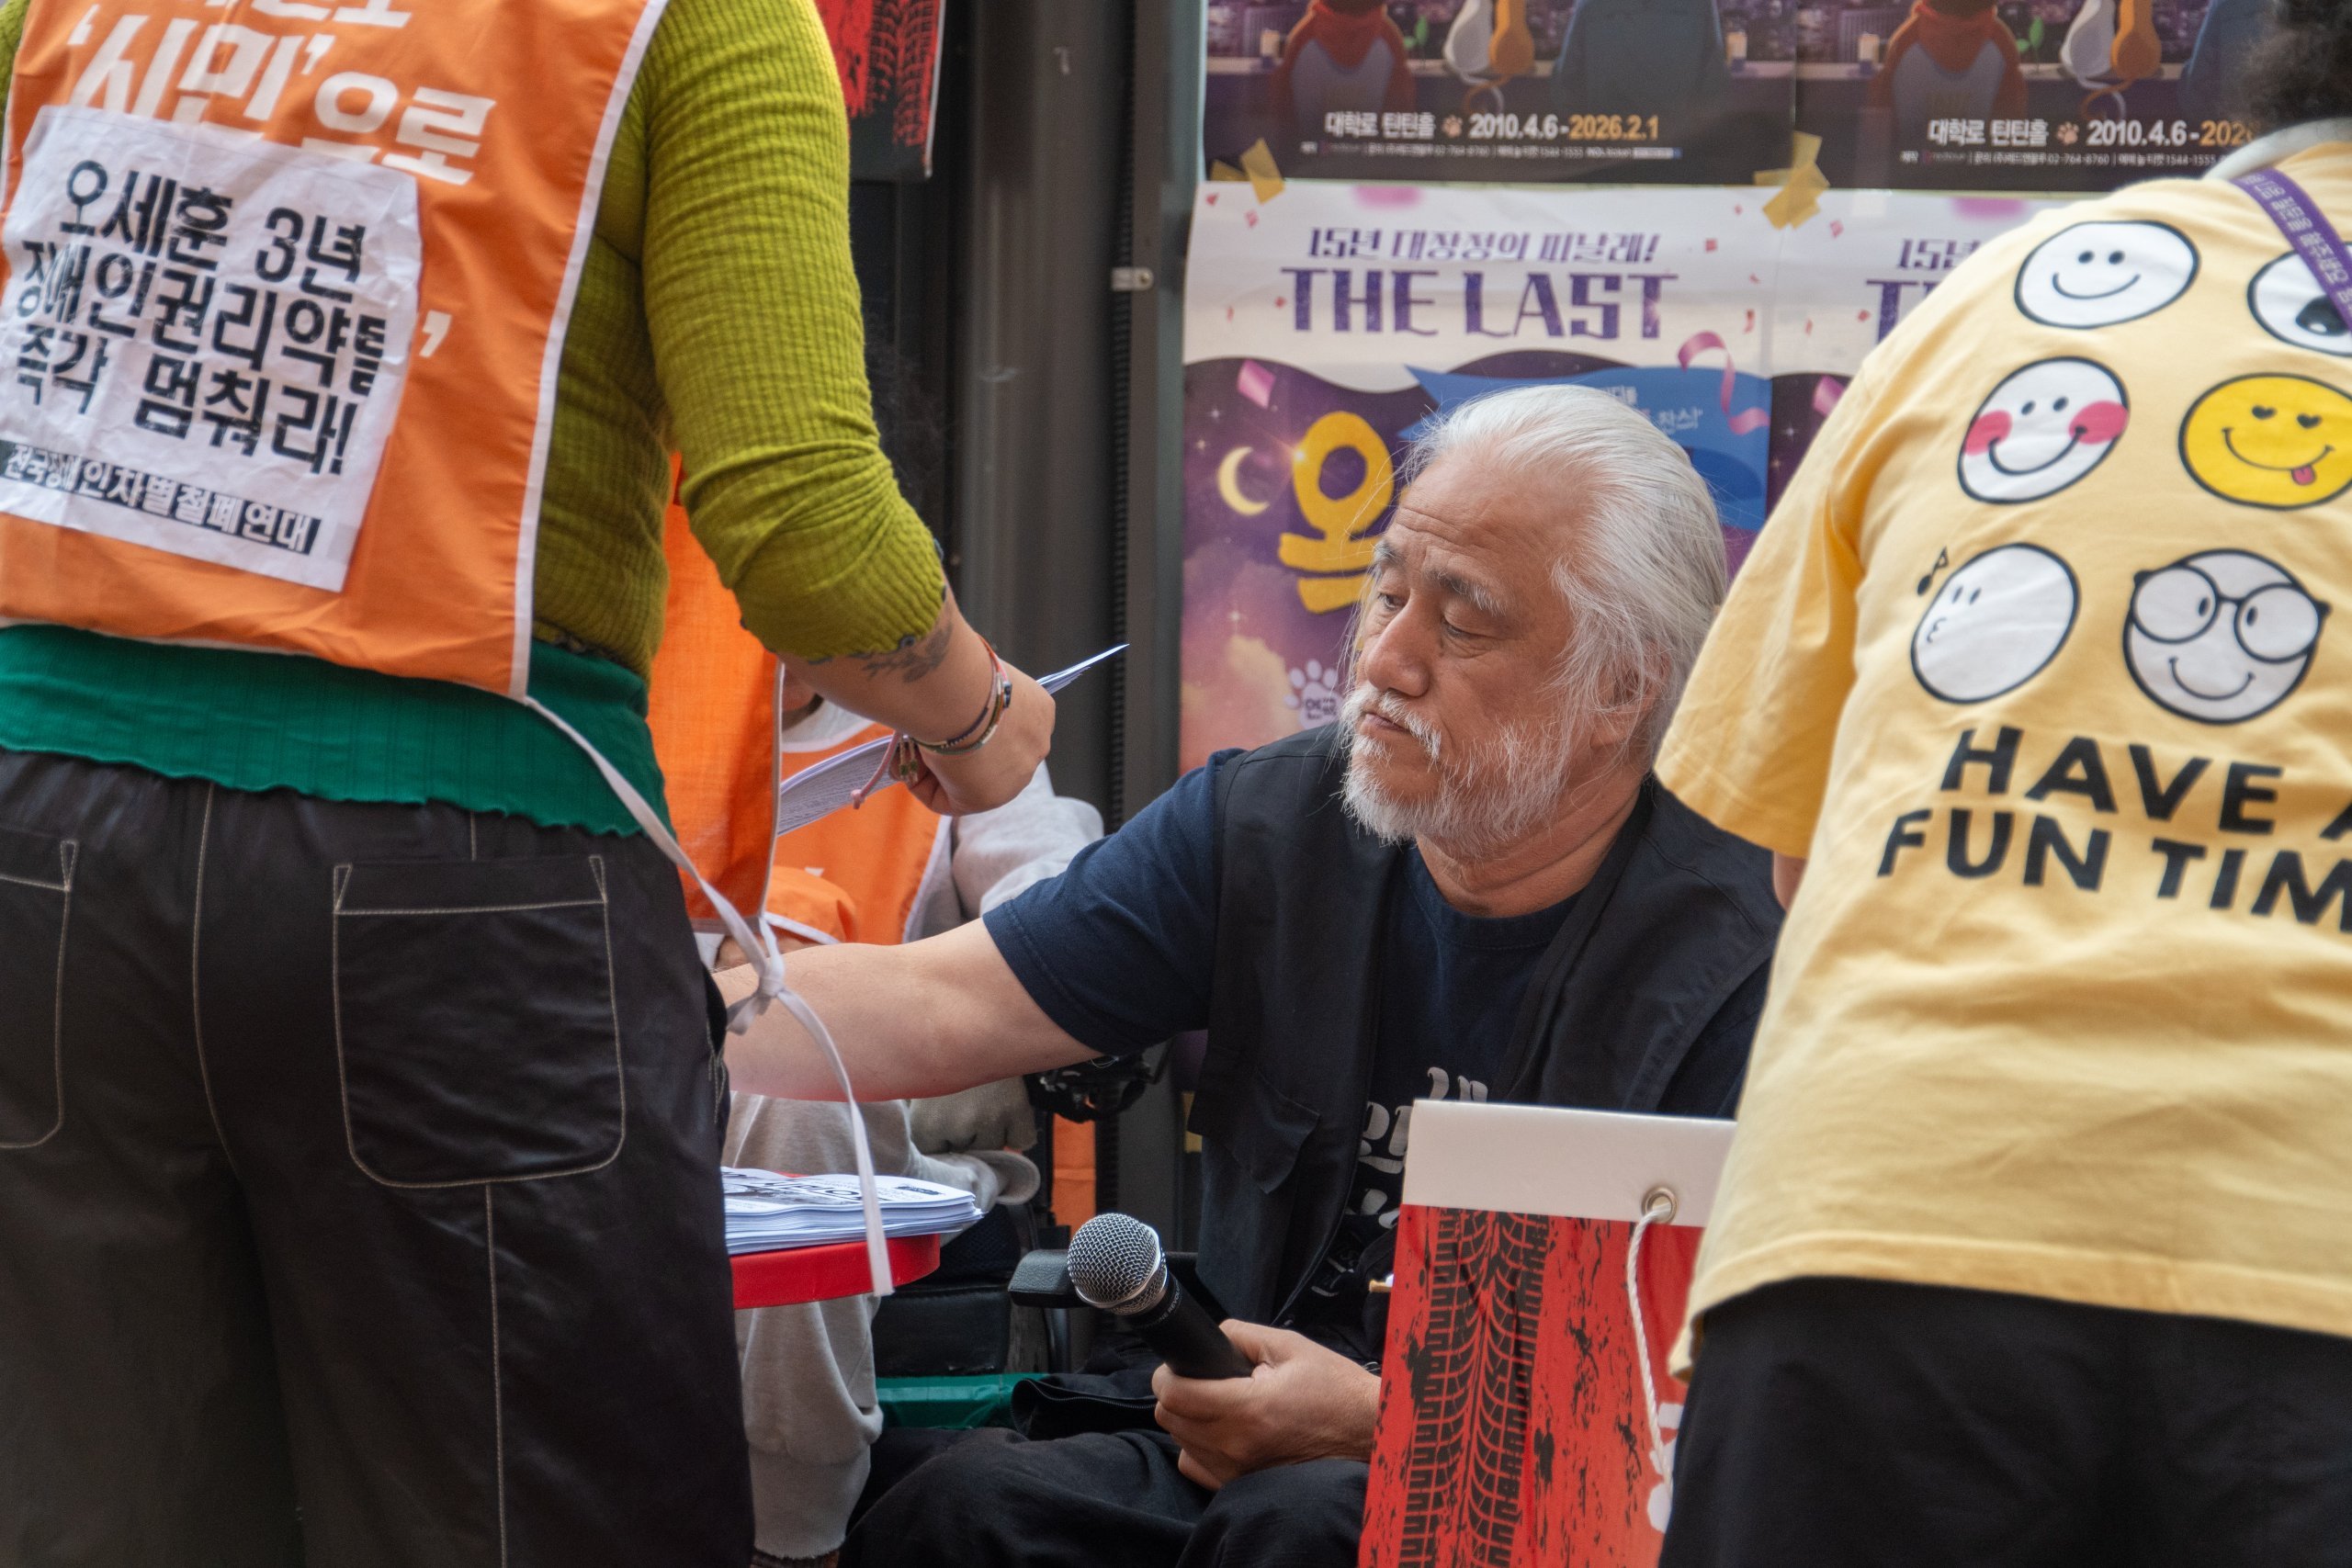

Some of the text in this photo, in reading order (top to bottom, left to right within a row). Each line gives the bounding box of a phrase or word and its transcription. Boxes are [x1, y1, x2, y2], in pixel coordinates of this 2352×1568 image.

[1324, 111, 1378, 137] 대학로
[1928, 118, 1985, 146] 대학로
[58, 159, 367, 301] 오세훈 3년
[1308, 227, 1661, 264] 15년 대장정의 피날레!
[1280, 267, 1679, 339] THE LAST
[15, 323, 359, 476] 즉각 멈춰라!
[1939, 726, 2284, 836] HAVE
[1876, 808, 2112, 892] FUN
